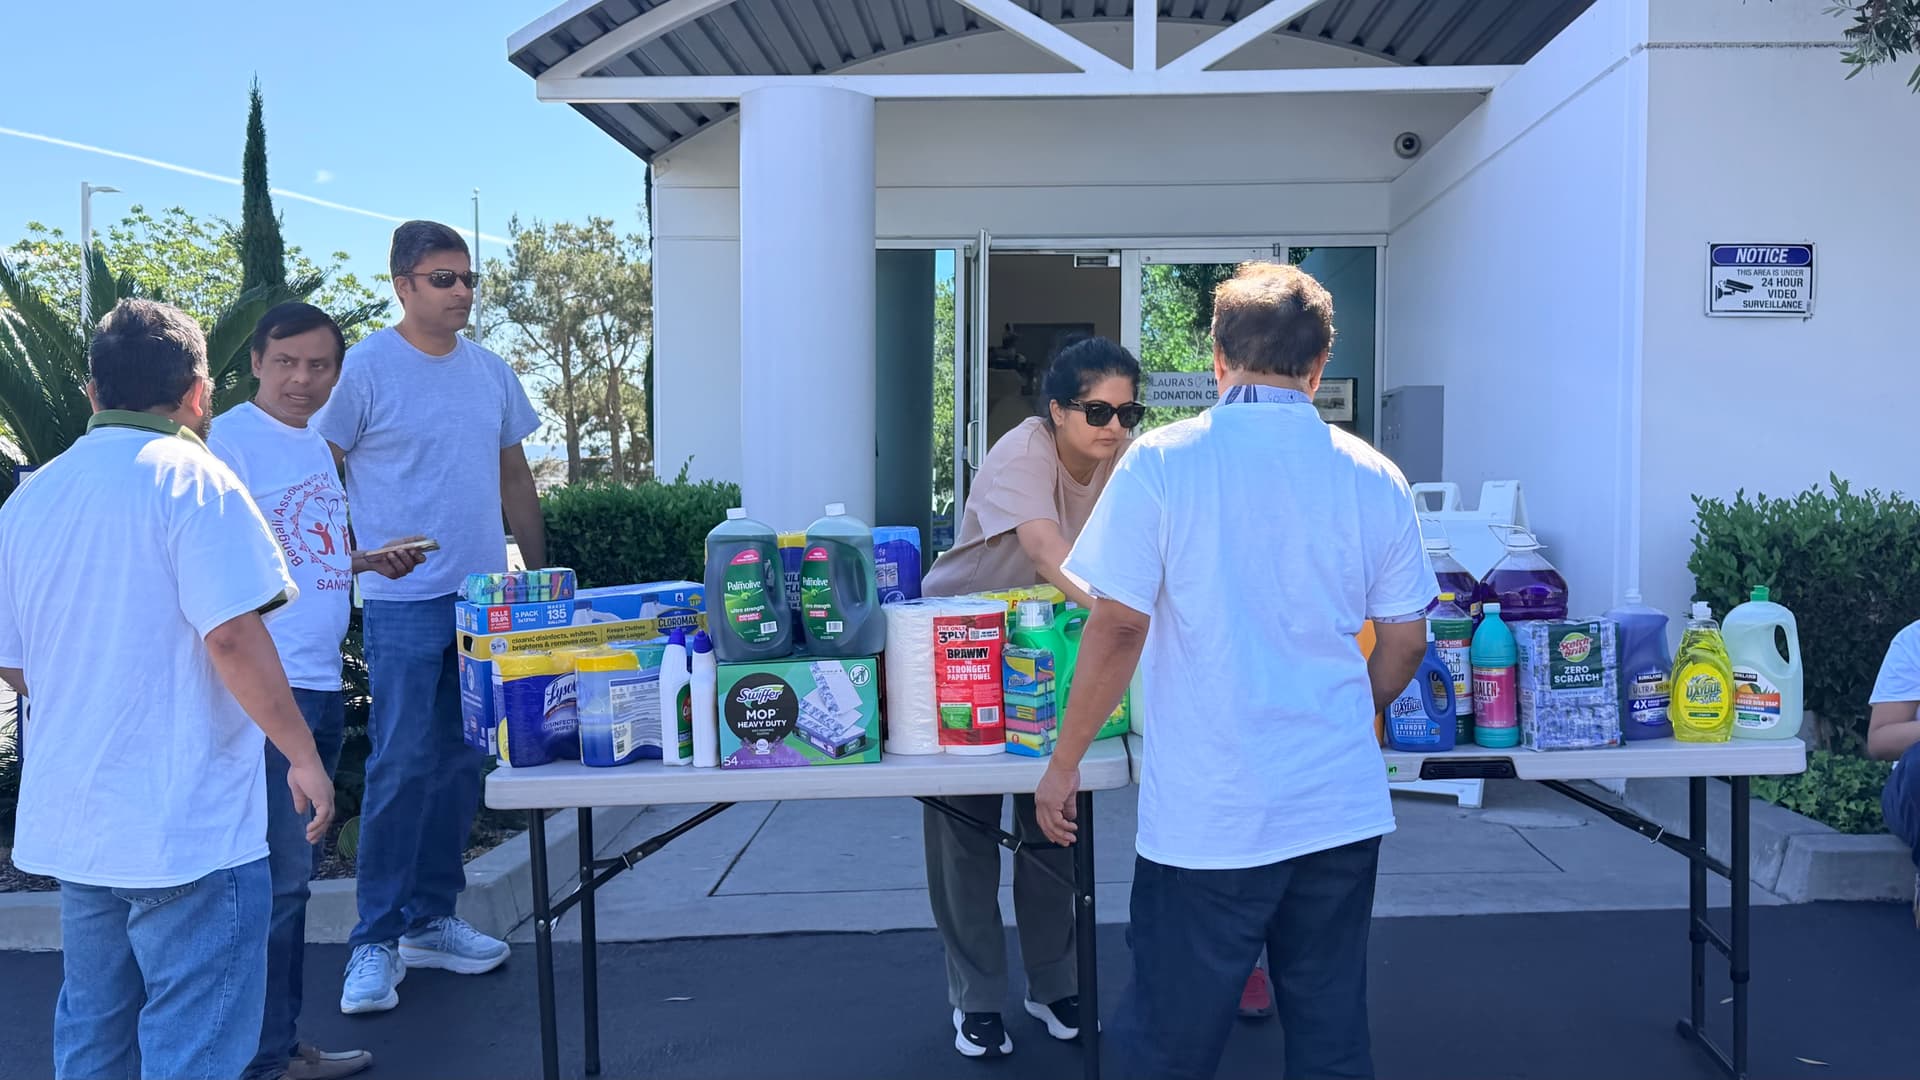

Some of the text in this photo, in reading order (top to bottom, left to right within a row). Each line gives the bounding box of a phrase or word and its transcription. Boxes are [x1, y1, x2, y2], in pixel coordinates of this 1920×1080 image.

[1736, 248, 1789, 263] NOTICE
[1761, 278, 1804, 287] 24 HOUR
[1768, 289, 1797, 299] VIDEO
[1742, 300, 1803, 309] SURVEILLANCE
[1153, 391, 1202, 400] DONATION
[272, 520, 304, 567] Bengali
[727, 580, 761, 591] Palmolive
[802, 577, 828, 586] Palmolive
[521, 610, 538, 618] PACK
[744, 605, 765, 613] strength
[547, 609, 567, 620] 135
[658, 615, 698, 628] CLOROMAX
[947, 647, 988, 659] BRAWNY
[947, 665, 991, 674] STRONGEST
[1564, 665, 1589, 674] ZERO
[969, 672, 991, 680] TOWEL
[1554, 673, 1600, 683] SCRATCH
[546, 681, 576, 706] Lysol
[736, 687, 783, 705] Swiffer
[1633, 700, 1647, 709] 4X
[746, 709, 776, 720] MOP
[766, 719, 787, 727] DUTY
[723, 756, 738, 766] 54
